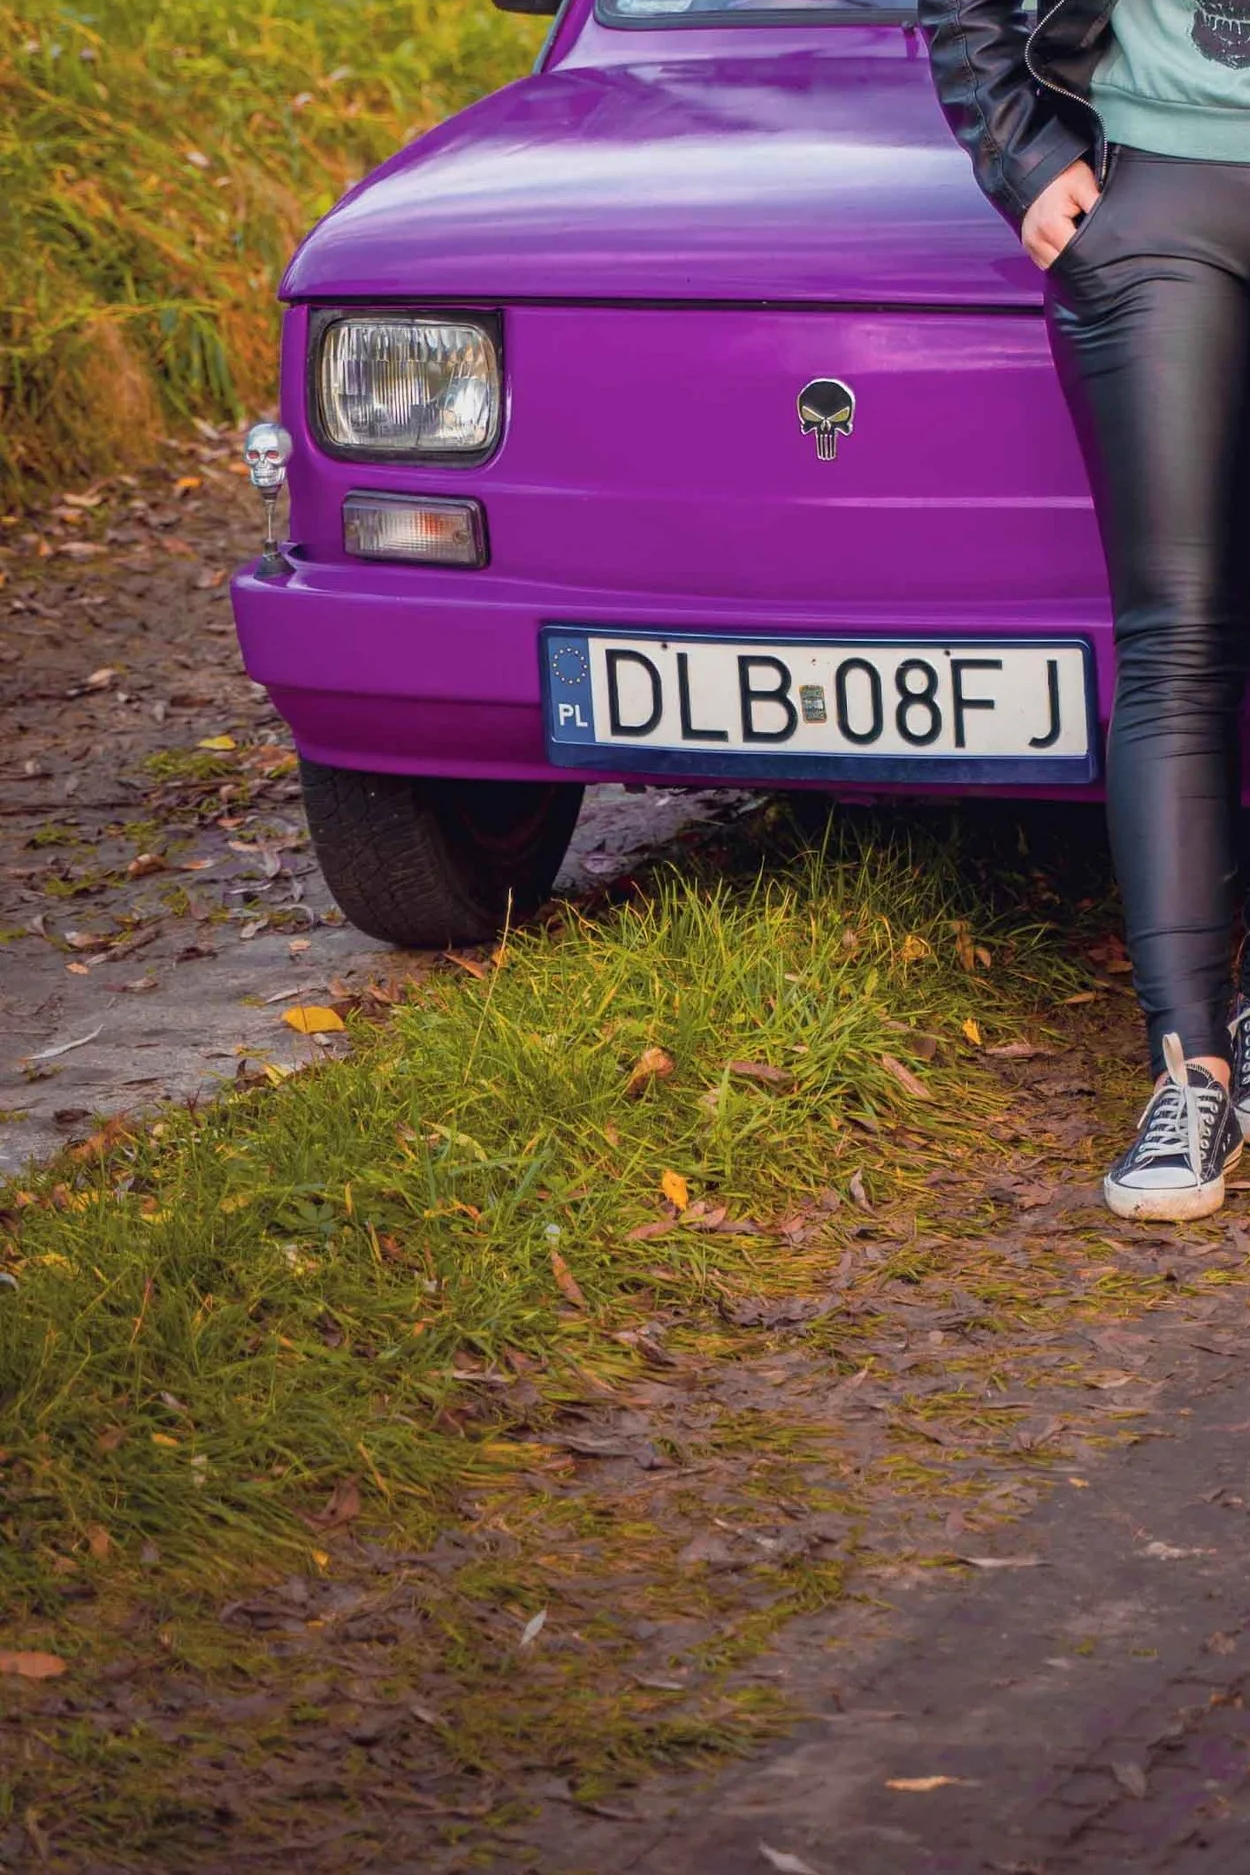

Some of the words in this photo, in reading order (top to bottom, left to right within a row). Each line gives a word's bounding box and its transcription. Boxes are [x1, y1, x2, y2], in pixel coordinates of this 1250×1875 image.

[559, 703, 588, 727] PL
[605, 648, 799, 744] DLB
[835, 657, 1061, 749] 08FJ
